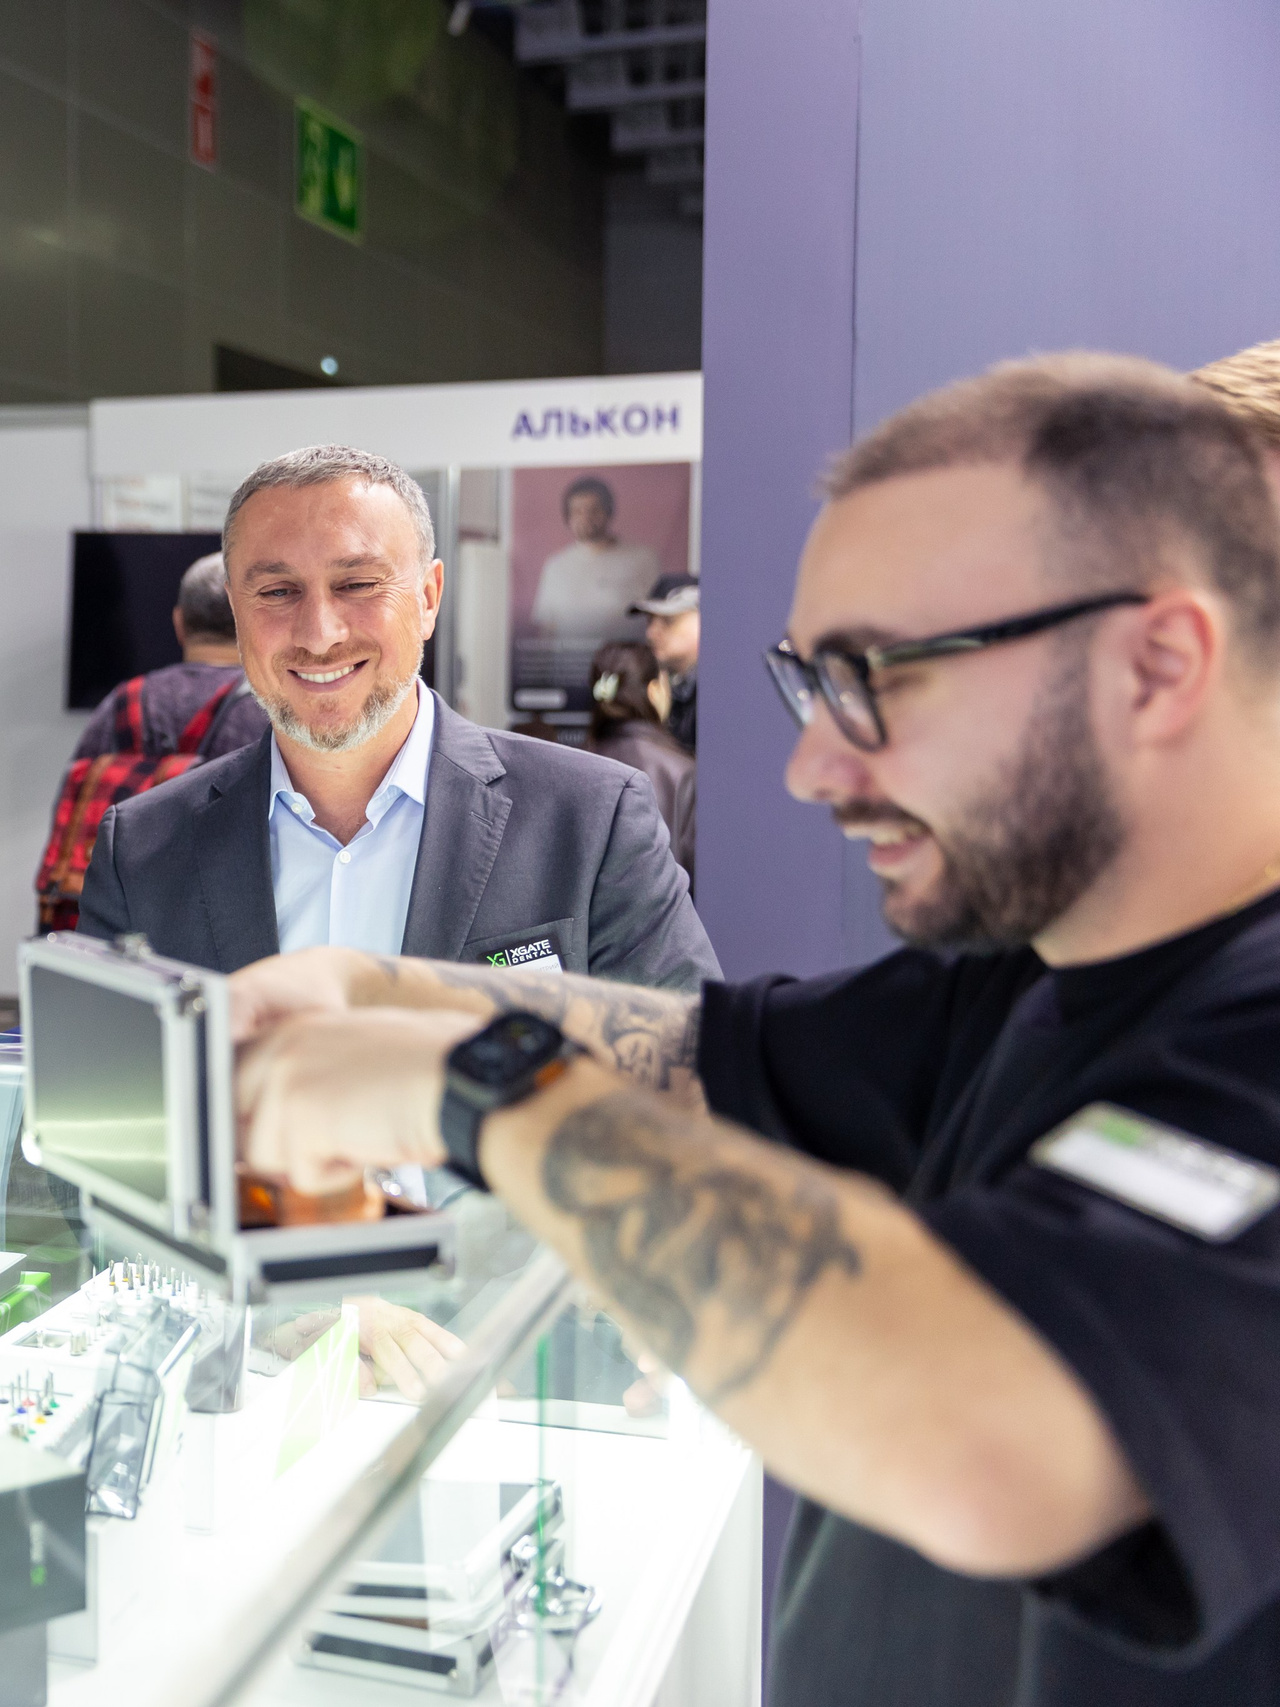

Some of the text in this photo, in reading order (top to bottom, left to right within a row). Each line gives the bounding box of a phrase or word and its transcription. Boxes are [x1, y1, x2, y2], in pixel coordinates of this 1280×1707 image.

[511, 402, 680, 440] АЛЬКОН
[510, 939, 551, 958] XGATE
[511, 949, 553, 964] DENTAL
